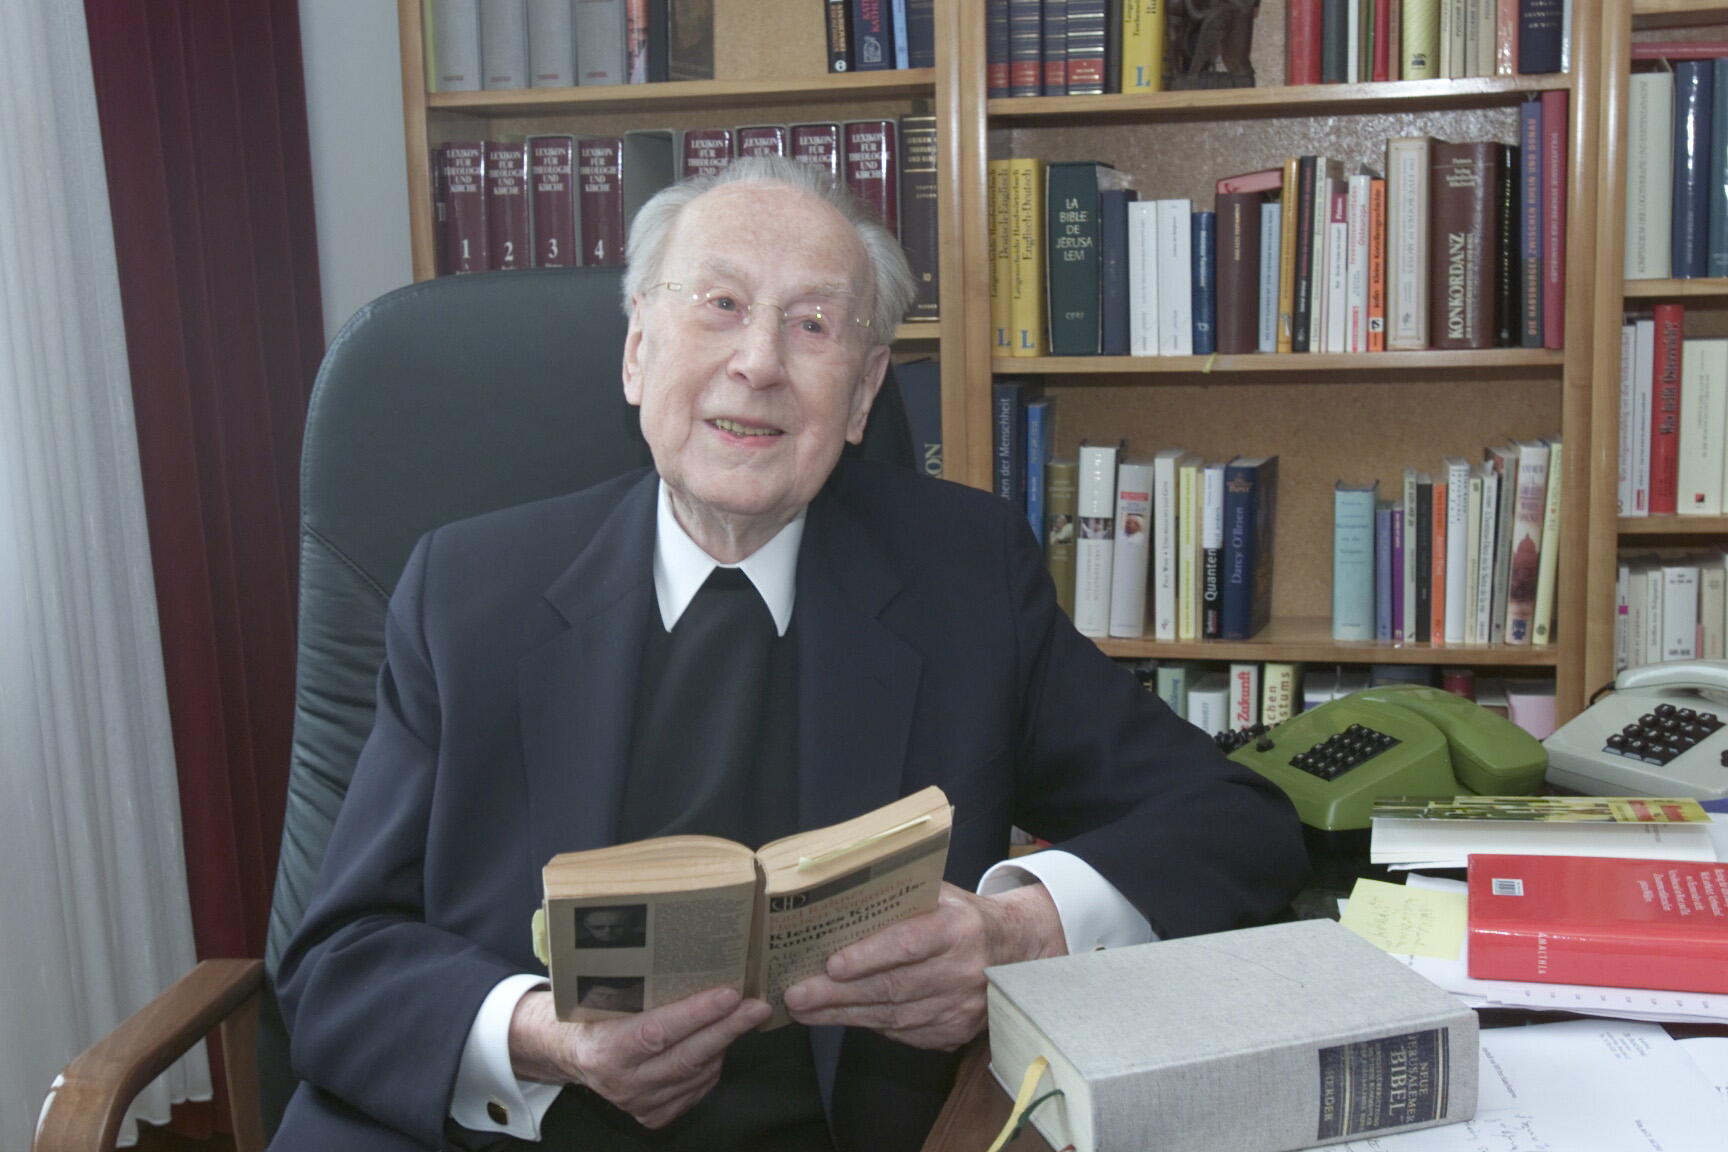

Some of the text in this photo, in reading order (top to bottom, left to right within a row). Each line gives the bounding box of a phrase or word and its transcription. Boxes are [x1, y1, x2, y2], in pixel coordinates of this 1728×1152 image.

[998, 169, 1010, 259] Deutsch-Englisch
[1022, 169, 1034, 261] Englisch-Deutsch
[1059, 211, 1088, 222] BIBLE
[1066, 198, 1079, 209] LA
[1528, 118, 1537, 335] DIE HABSBURGER ZWISCHEN RHEIN UND DONAU
[461, 239, 471, 259] 1
[504, 241, 514, 261] 2
[548, 238, 559, 259] 3
[594, 239, 605, 260] 4
[1066, 224, 1081, 235] DE
[1063, 251, 1085, 261] LEM
[1449, 233, 1465, 339] KONKORDANZ
[1021, 330, 1035, 349] L
[1661, 321, 1679, 383] Österreich?
[999, 397, 1010, 457] Menschheit
[1660, 416, 1675, 435] Was
[999, 459, 1010, 477] der
[1231, 507, 1244, 584] Darcy O'Brien
[1204, 548, 1217, 601] Quanten
[1238, 671, 1251, 722] Zukunft
[1265, 686, 1277, 728] chen
[1278, 671, 1290, 724] stums
[769, 901, 900, 950] kompendium
[770, 915, 845, 942] Kleines
[850, 881, 926, 917] Konzils-
[1324, 1070, 1334, 1121] HERDER
[1389, 1049, 1406, 1116] BIBEL
[1405, 1035, 1419, 1124] JERUSALEMER
[1418, 1061, 1429, 1096] NEUE
